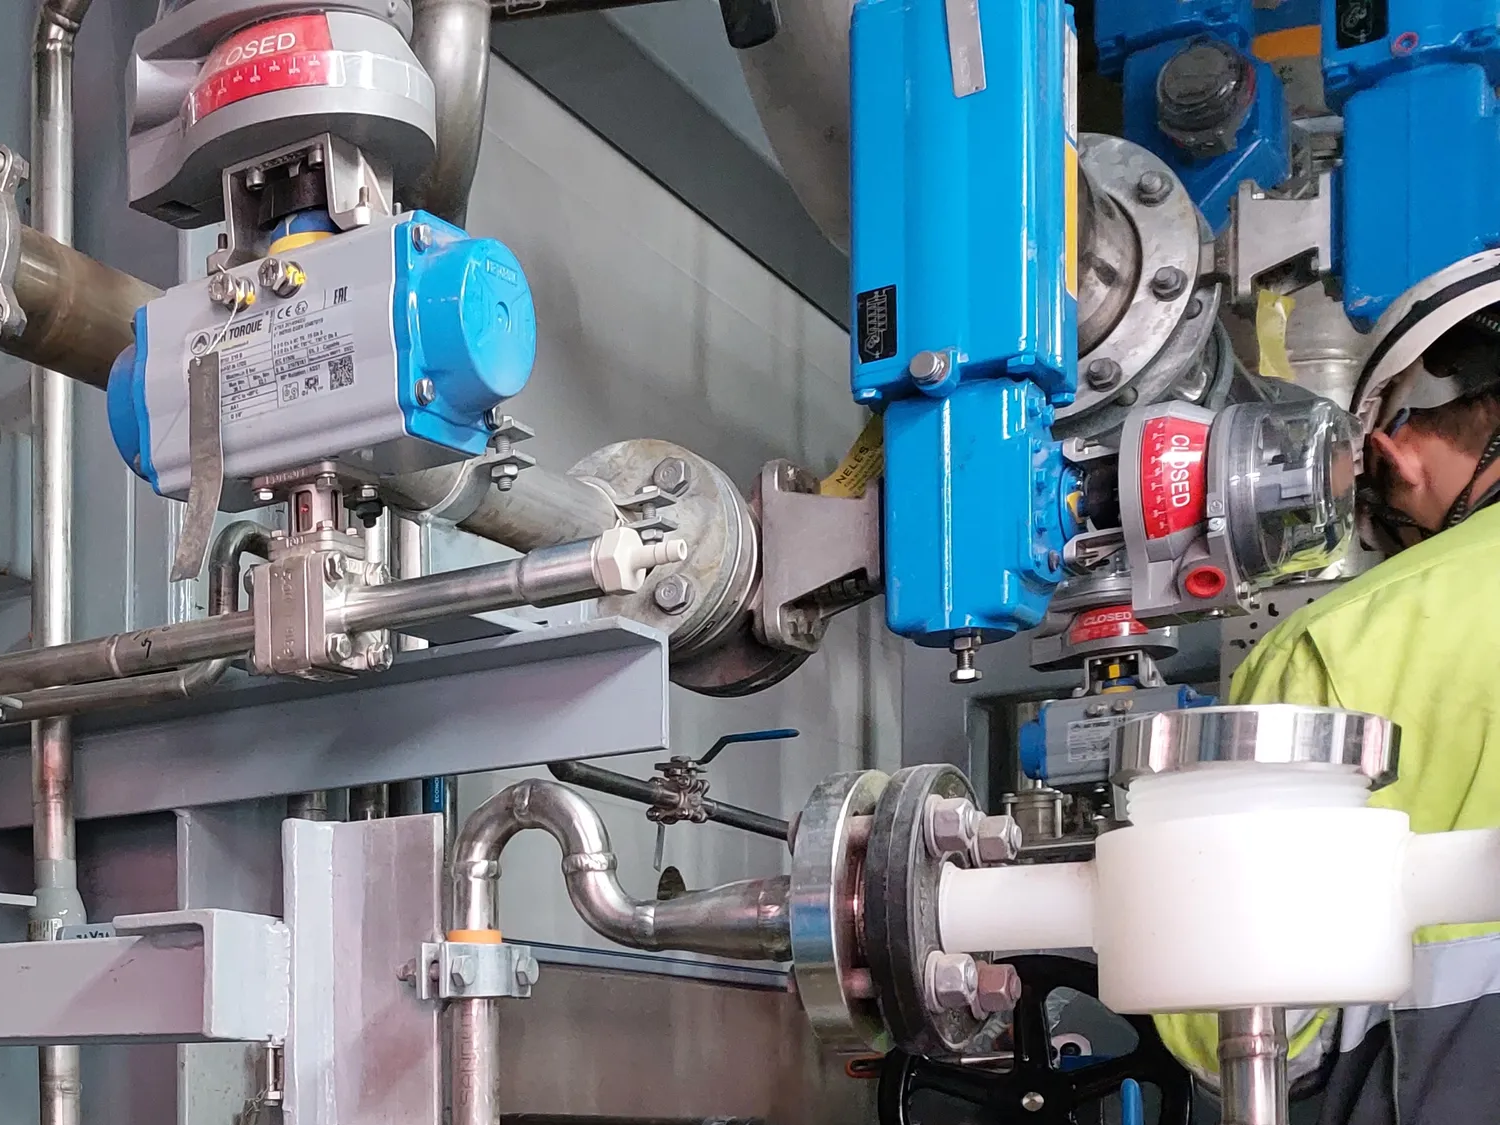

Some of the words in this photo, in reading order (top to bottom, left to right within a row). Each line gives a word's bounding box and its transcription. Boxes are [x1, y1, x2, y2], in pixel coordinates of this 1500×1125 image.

[229, 319, 264, 338] TORQUE
[835, 446, 869, 484] NELES
[1083, 611, 1133, 627] CLOSED
